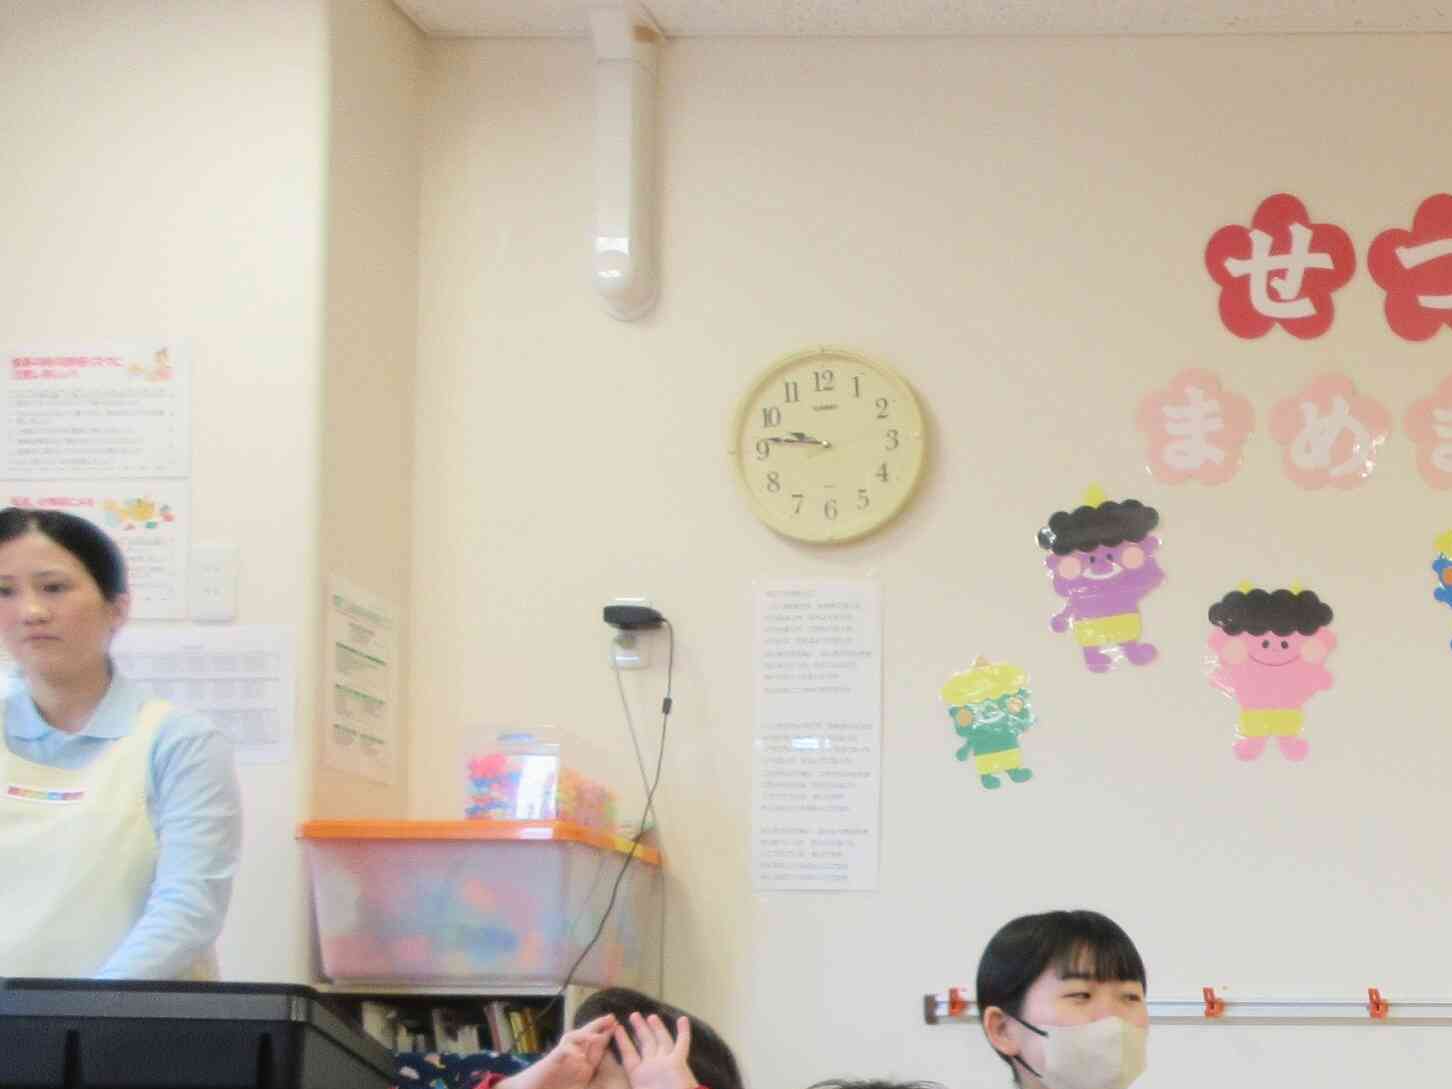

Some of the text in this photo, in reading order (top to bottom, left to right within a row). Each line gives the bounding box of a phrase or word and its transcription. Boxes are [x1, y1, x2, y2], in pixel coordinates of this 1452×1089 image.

[813, 369, 835, 392] 12
[852, 375, 860, 398] 1
[785, 381, 800, 403] 11
[763, 407, 781, 428] 10
[875, 398, 889, 419] 2
[756, 439, 770, 460] 9
[885, 429, 899, 450] 3
[766, 471, 781, 493] 8
[875, 463, 889, 483] 4
[791, 494, 804, 514] 7
[824, 499, 838, 520] 6
[857, 489, 870, 511] 5
